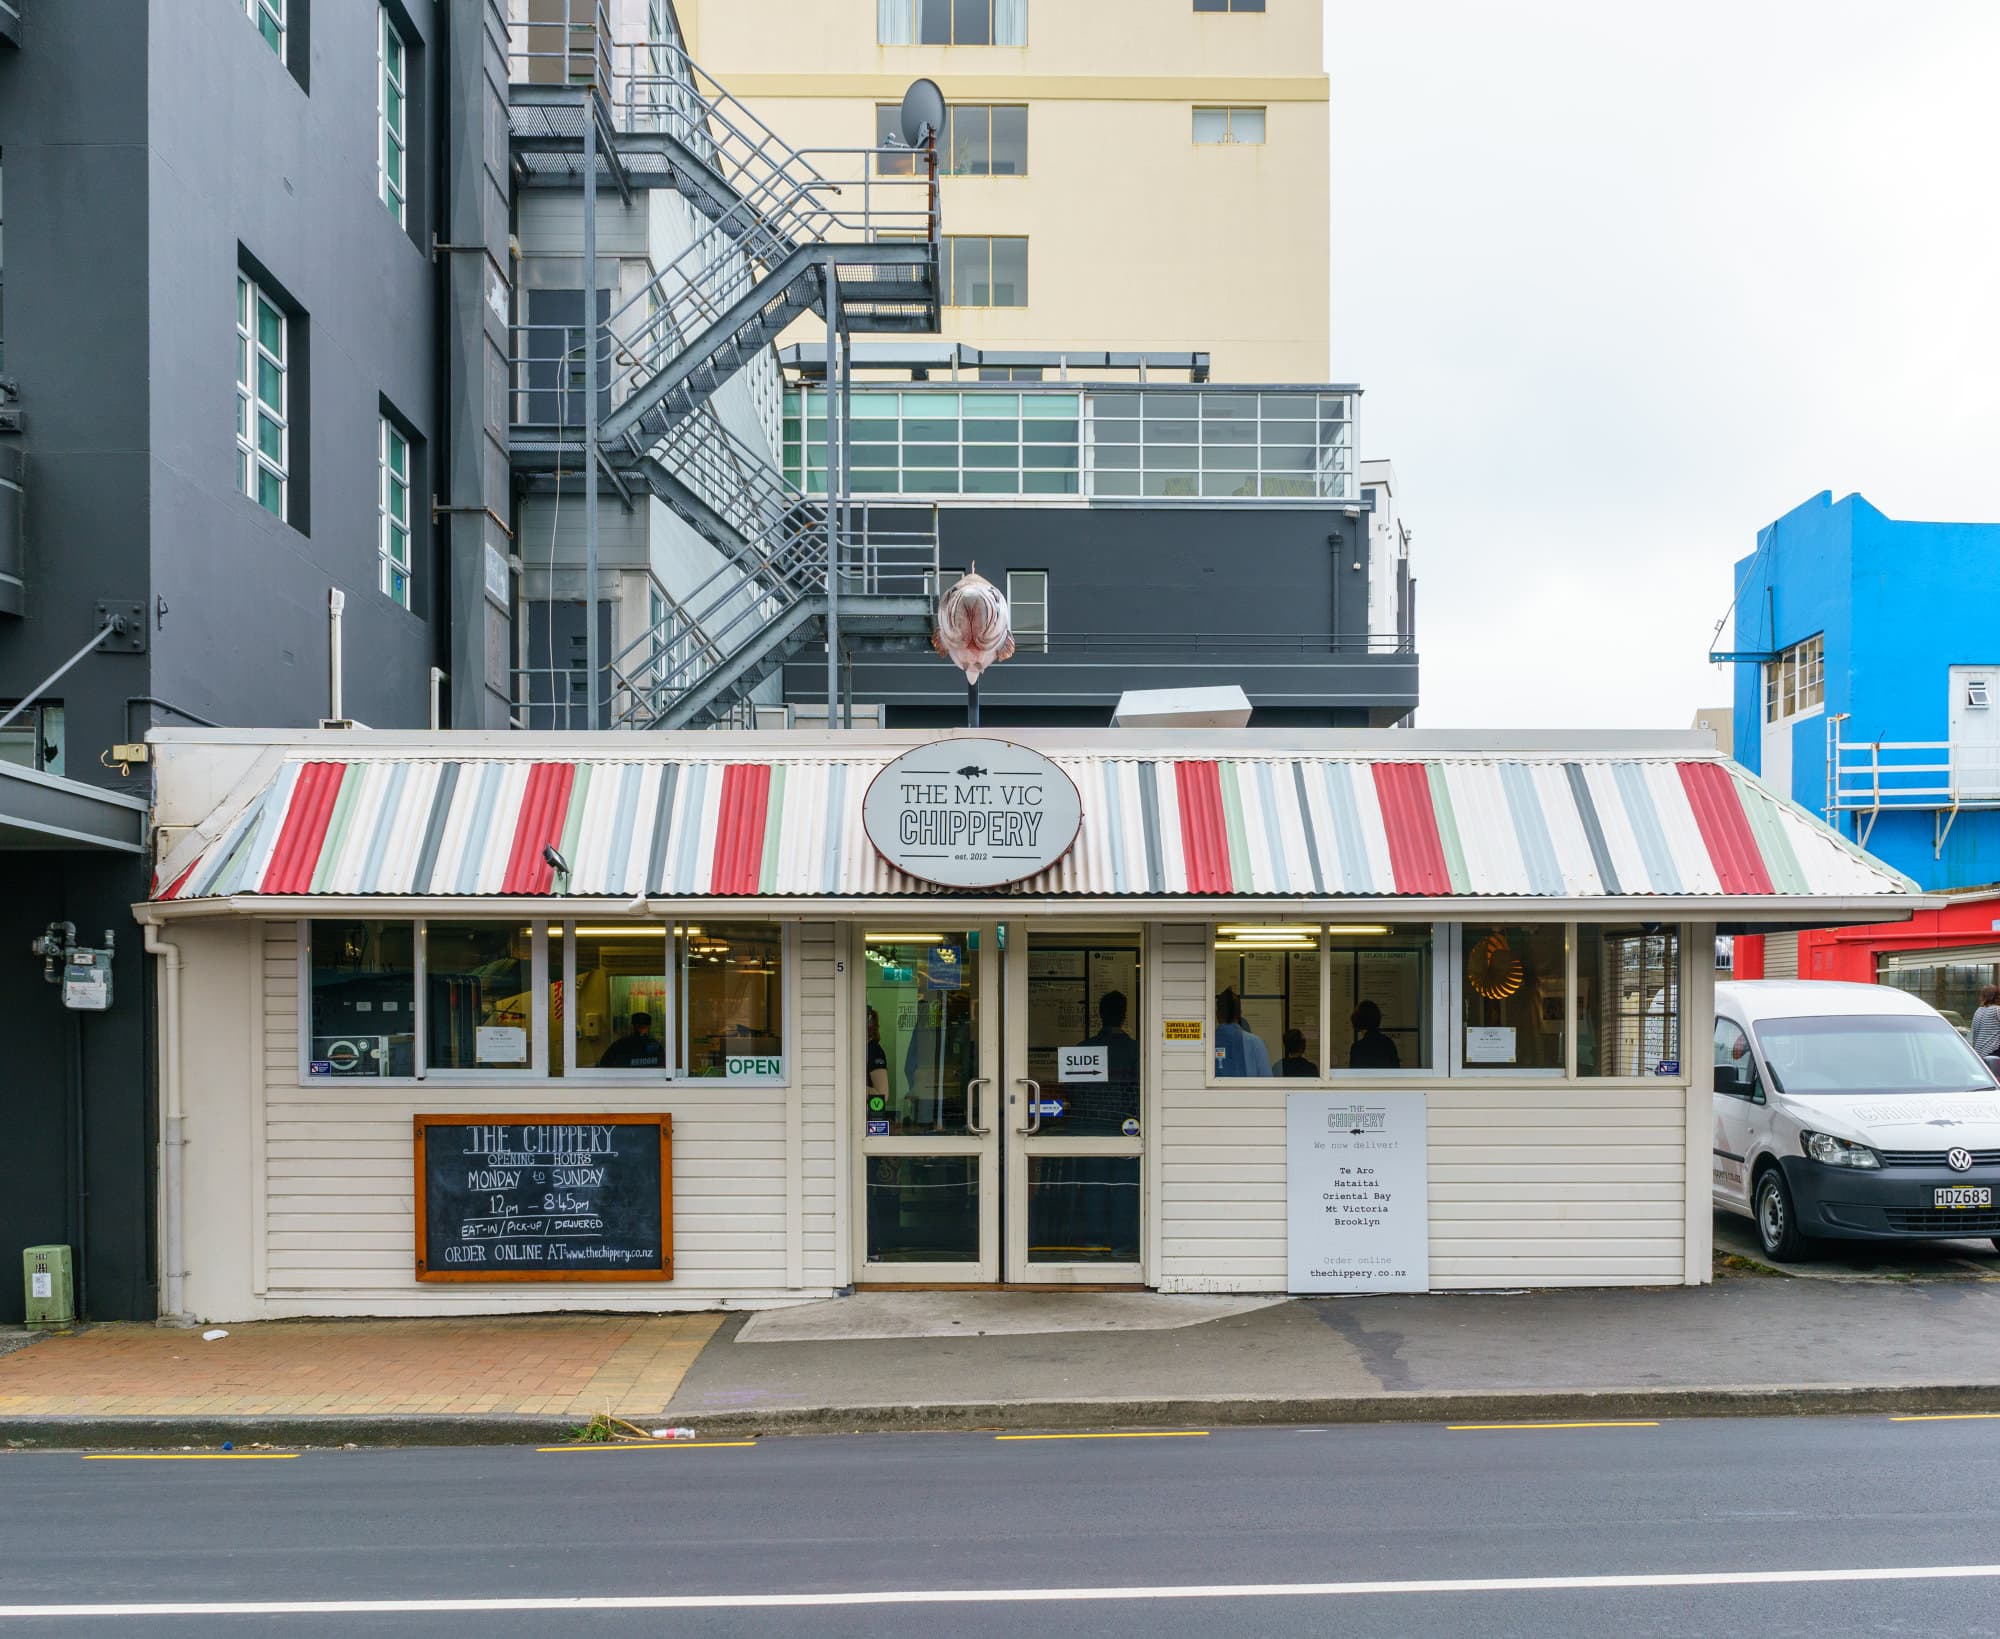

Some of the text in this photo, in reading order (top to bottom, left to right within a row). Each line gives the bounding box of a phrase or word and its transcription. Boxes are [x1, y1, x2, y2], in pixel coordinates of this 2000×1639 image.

[901, 784, 1043, 805] THE MT. VIC
[899, 810, 1043, 846] CHIPPERY
[837, 962, 844, 972] 5
[1066, 1055, 1100, 1066] SLIDE
[728, 1059, 780, 1074] OPEN
[1349, 1105, 1365, 1113] THE
[1327, 1113, 1385, 1128] CHIPPERY
[466, 1126, 616, 1153] THE CHIPPERY
[1314, 1142, 1325, 1150] We
[487, 1154, 592, 1165] OPENING HOURS
[468, 1168, 605, 1189] MONDAY to SUNDAY
[1323, 1192, 1391, 1201] Oriental Bay
[1936, 1190, 1989, 1204] HDZ683
[488, 1194, 518, 1217] 12pm
[1343, 1205, 1389, 1213] Victoria
[1335, 1218, 1380, 1227] Brooklyn
[444, 1245, 487, 1263] ORDER
[494, 1244, 543, 1260] ONLINE
[1323, 1256, 1392, 1264] Order online
[1310, 1269, 1407, 1278] thechippery.co.nz
